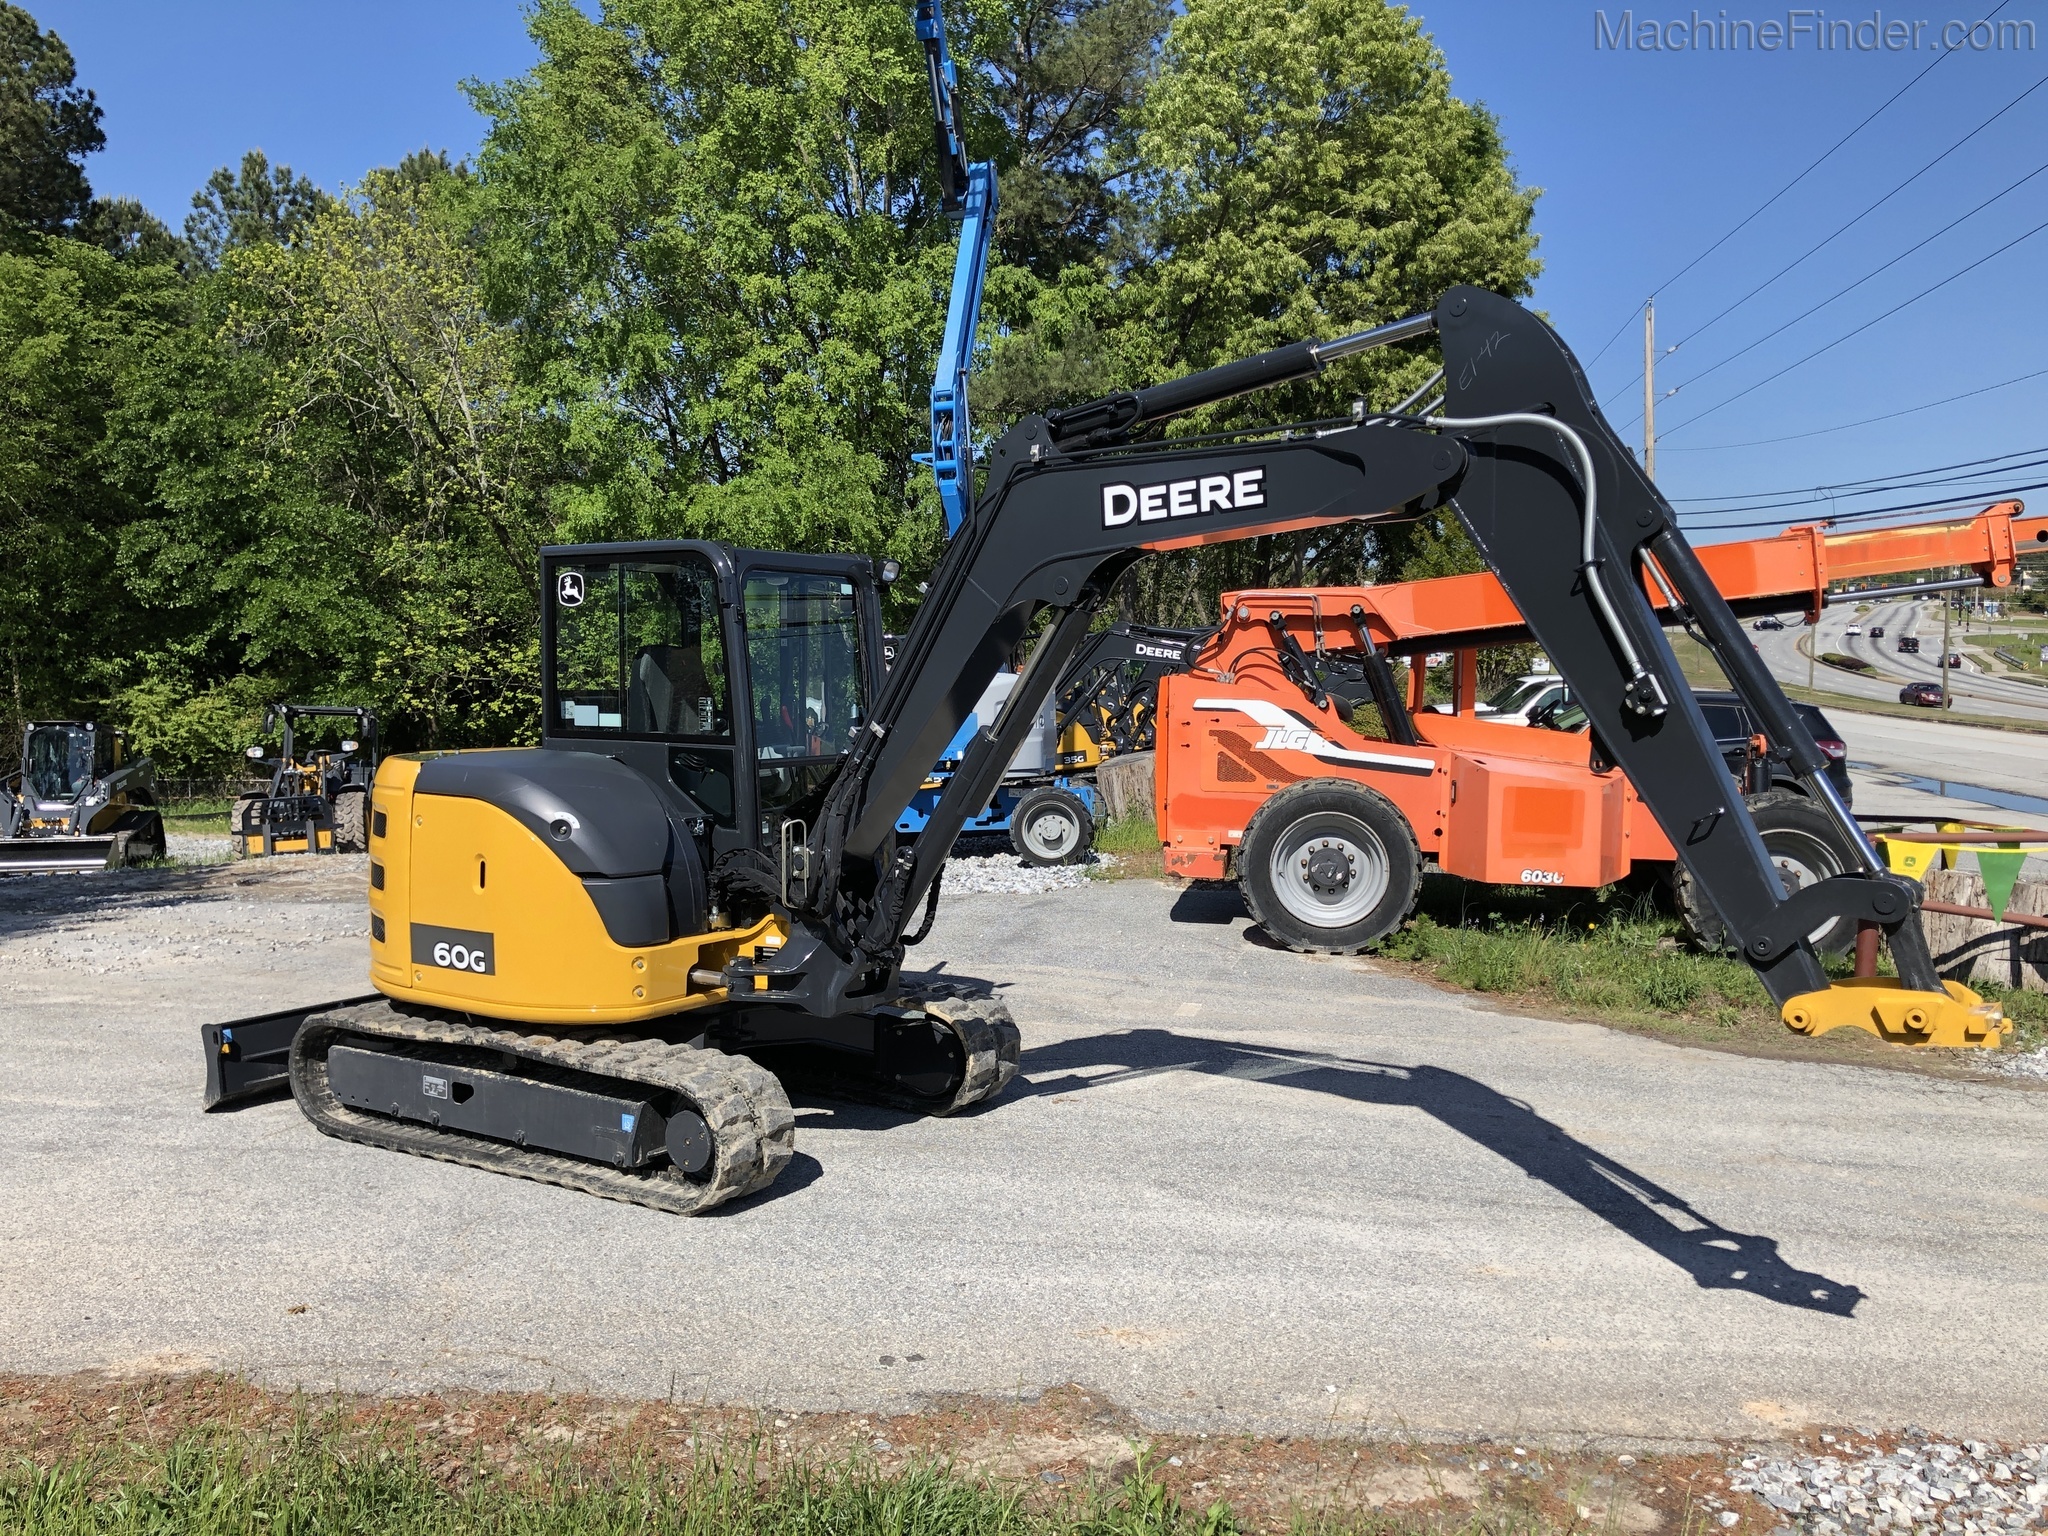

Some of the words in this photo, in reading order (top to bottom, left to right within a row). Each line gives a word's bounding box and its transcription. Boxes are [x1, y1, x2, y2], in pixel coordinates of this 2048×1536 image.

[1102, 468, 1265, 528] DEERE
[1135, 643, 1182, 660] DEERE
[1254, 729, 1311, 751] JLG
[1063, 755, 1085, 764] 35G
[433, 941, 486, 973] 60G
